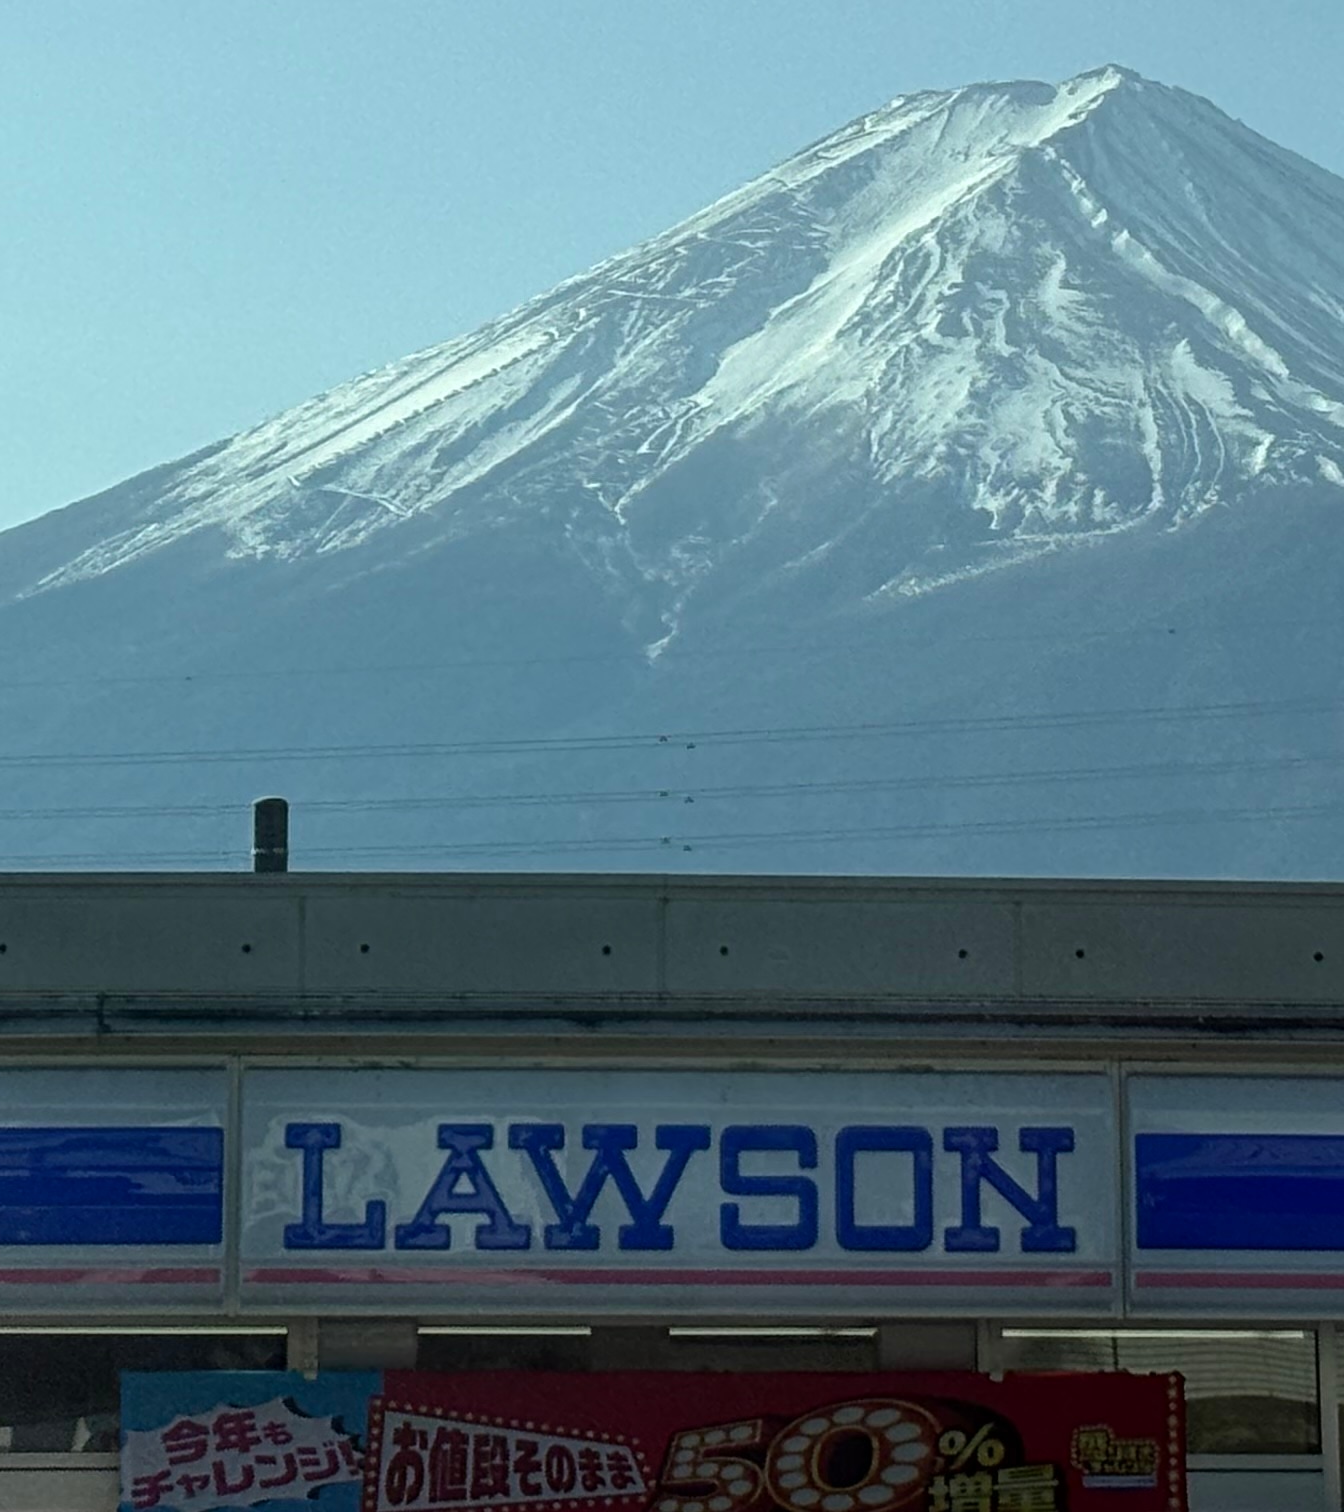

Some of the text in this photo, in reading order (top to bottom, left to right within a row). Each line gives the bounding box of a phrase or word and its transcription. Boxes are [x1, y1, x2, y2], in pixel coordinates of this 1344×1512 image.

[284, 1122, 1077, 1253] LAWSON
[162, 1410, 294, 1466] 今年も
[385, 1420, 637, 1506] お値段そのまま
